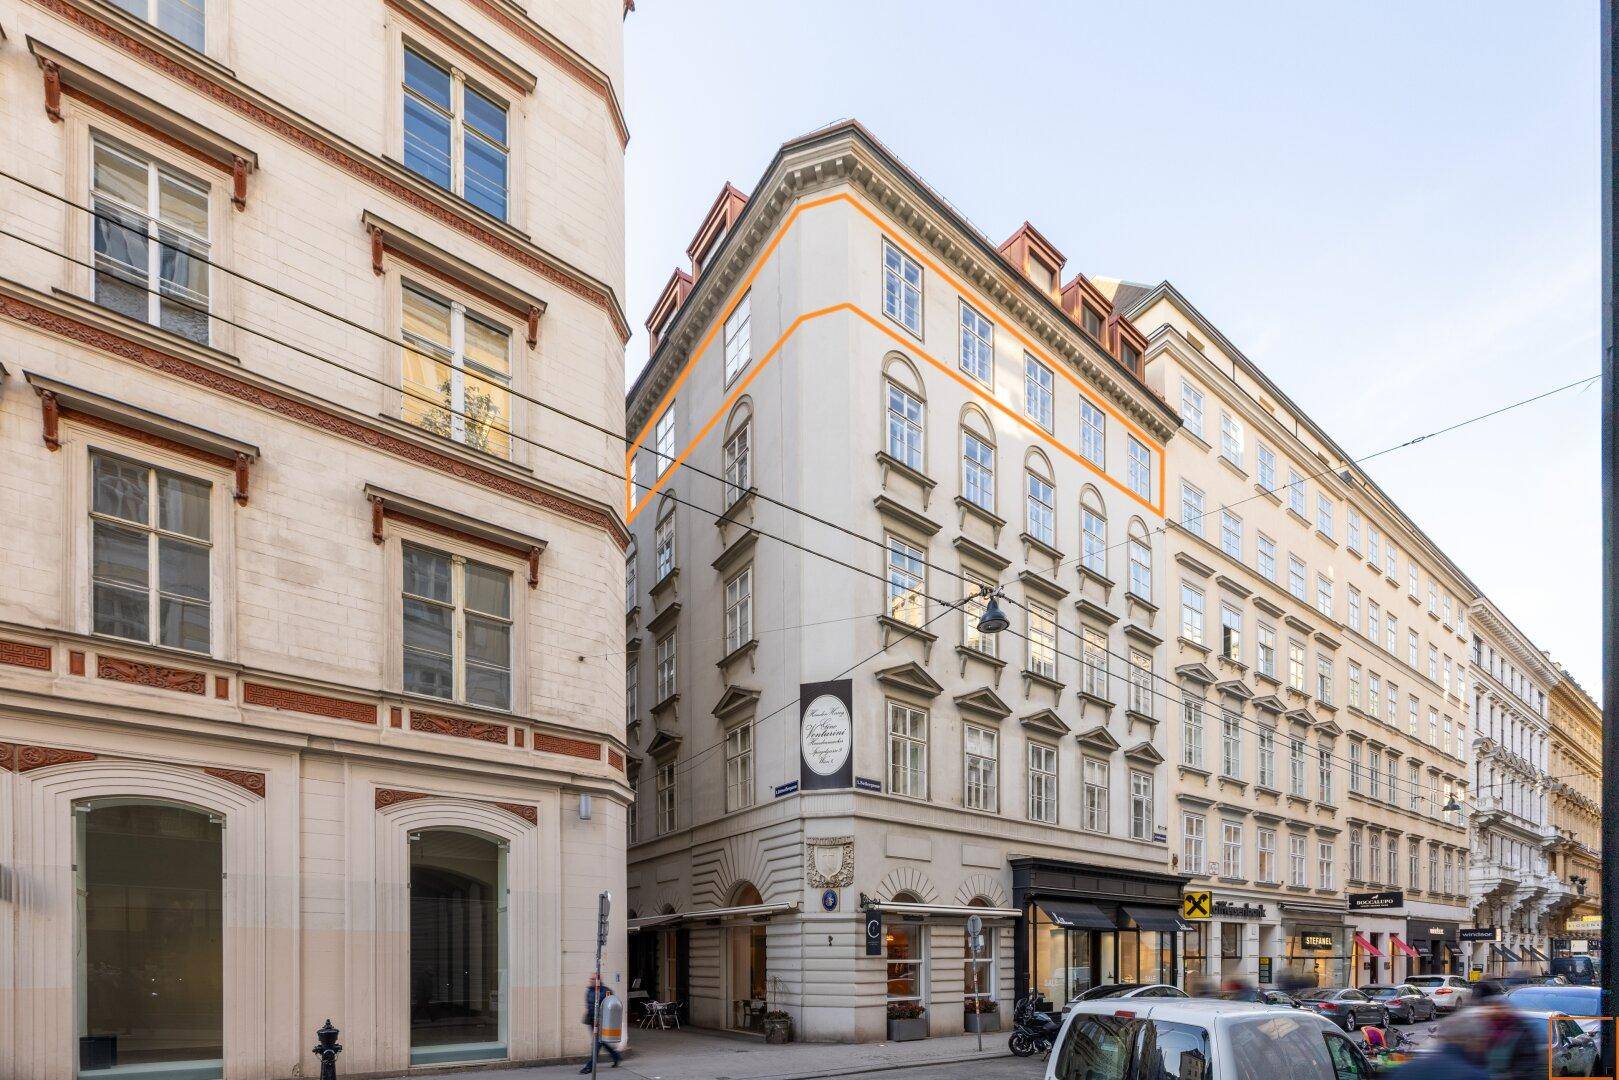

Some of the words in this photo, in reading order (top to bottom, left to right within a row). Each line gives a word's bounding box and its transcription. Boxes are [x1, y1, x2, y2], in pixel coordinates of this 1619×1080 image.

[819, 718, 838, 730] Gino
[805, 724, 847, 740] Venturini
[1211, 901, 1267, 918] aiffeisenbank
[1305, 936, 1332, 945] STEFANEL
